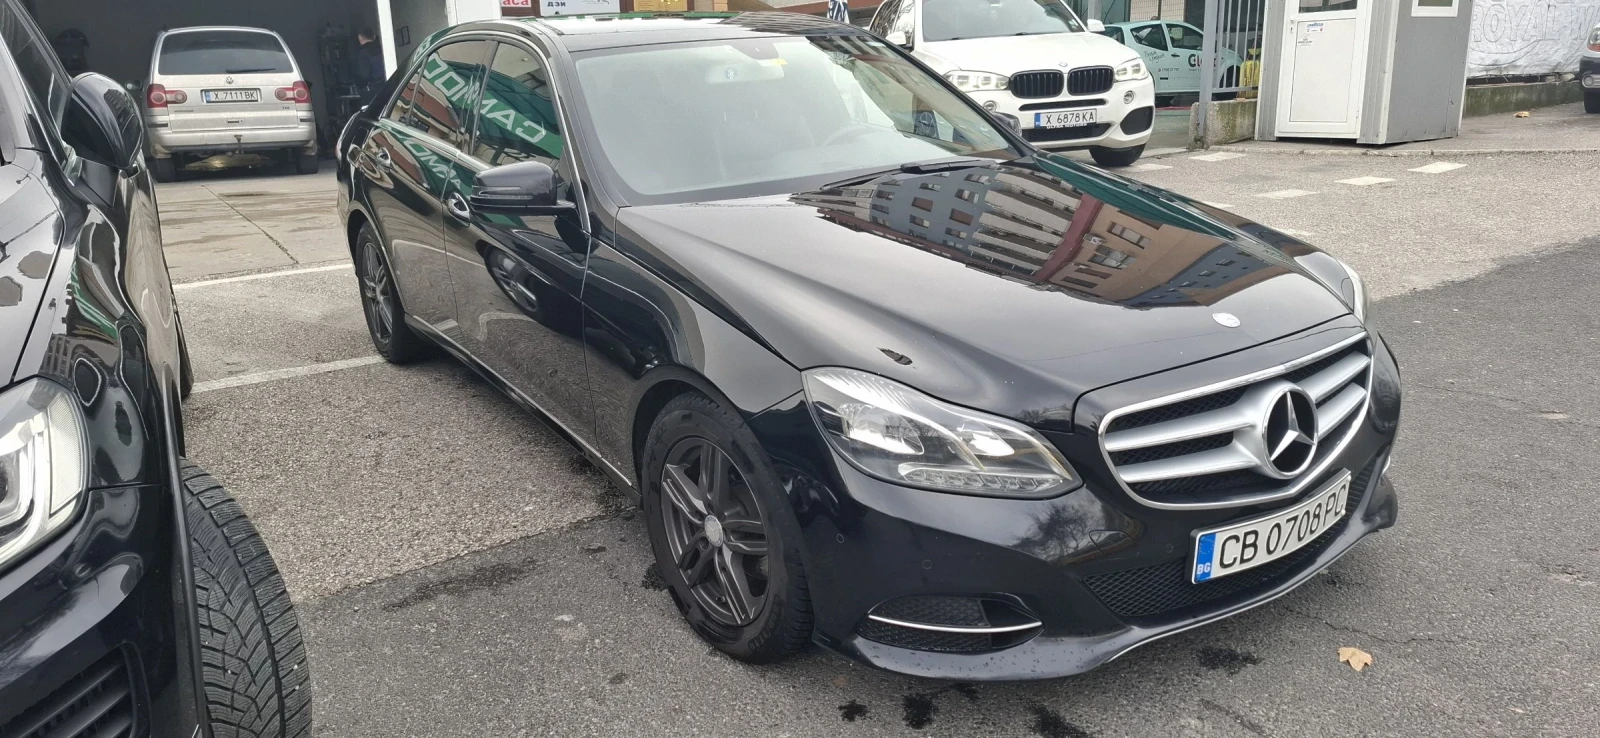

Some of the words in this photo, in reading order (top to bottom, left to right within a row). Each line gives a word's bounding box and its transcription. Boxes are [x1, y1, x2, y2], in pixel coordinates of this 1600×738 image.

[1219, 529, 1260, 569] CB
[1265, 502, 1322, 556] 0708
[1197, 562, 1211, 575] BG
